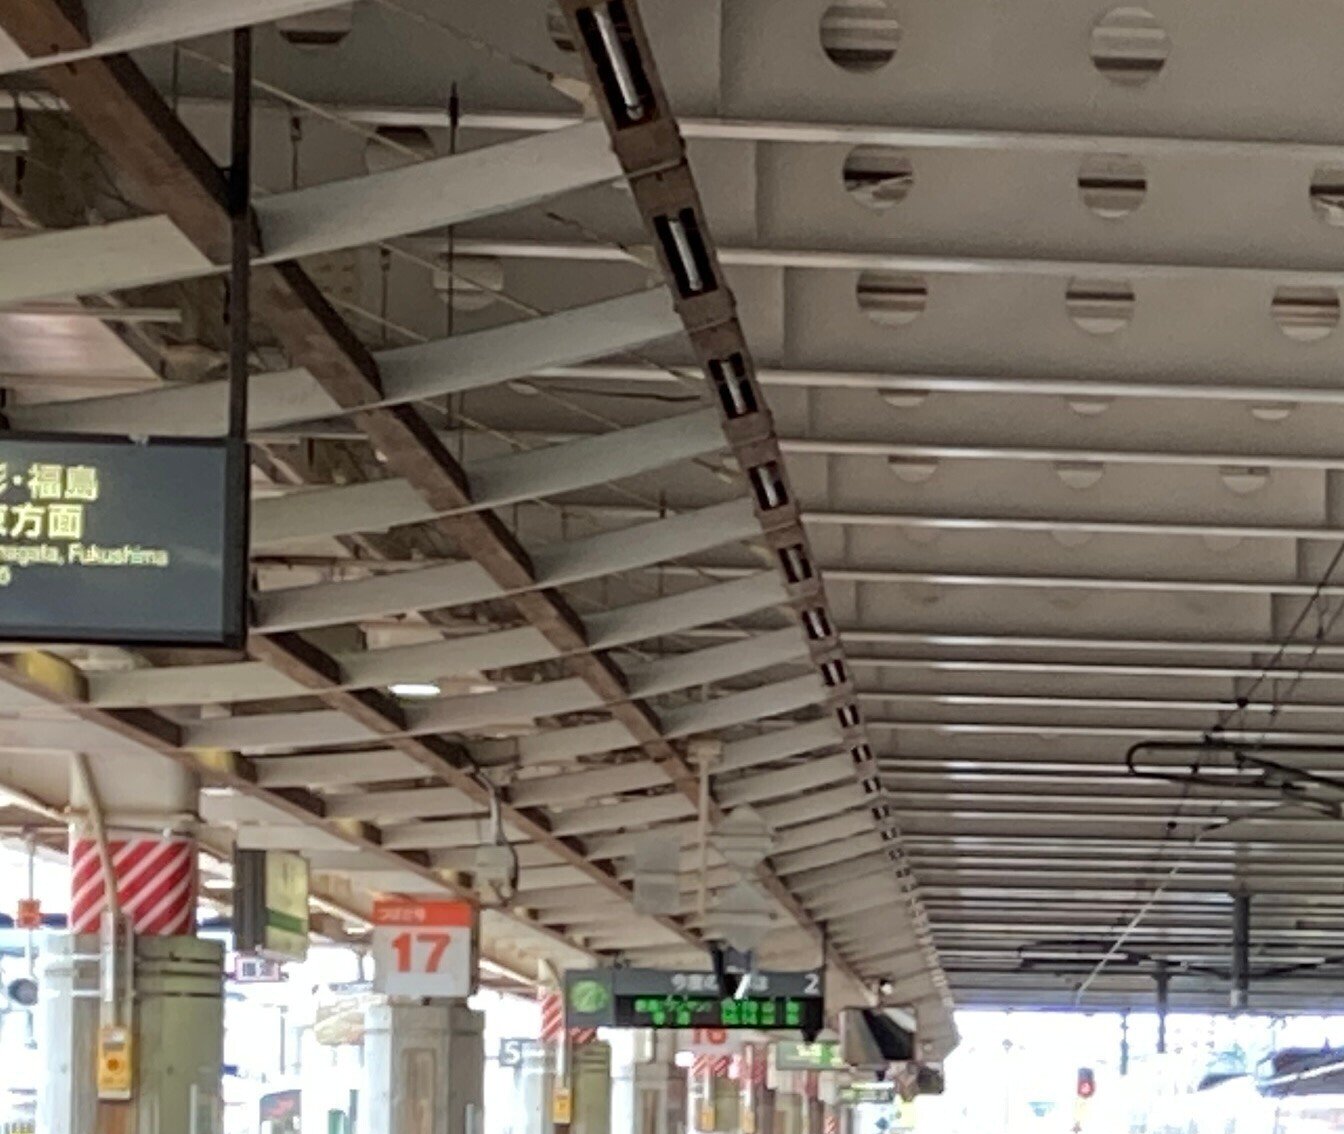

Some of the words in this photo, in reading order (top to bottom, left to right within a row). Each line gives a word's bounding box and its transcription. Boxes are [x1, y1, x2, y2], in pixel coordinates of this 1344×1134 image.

[69, 542, 169, 567] Fukushima
[391, 932, 452, 973] 17
[804, 973, 819, 993] 2
